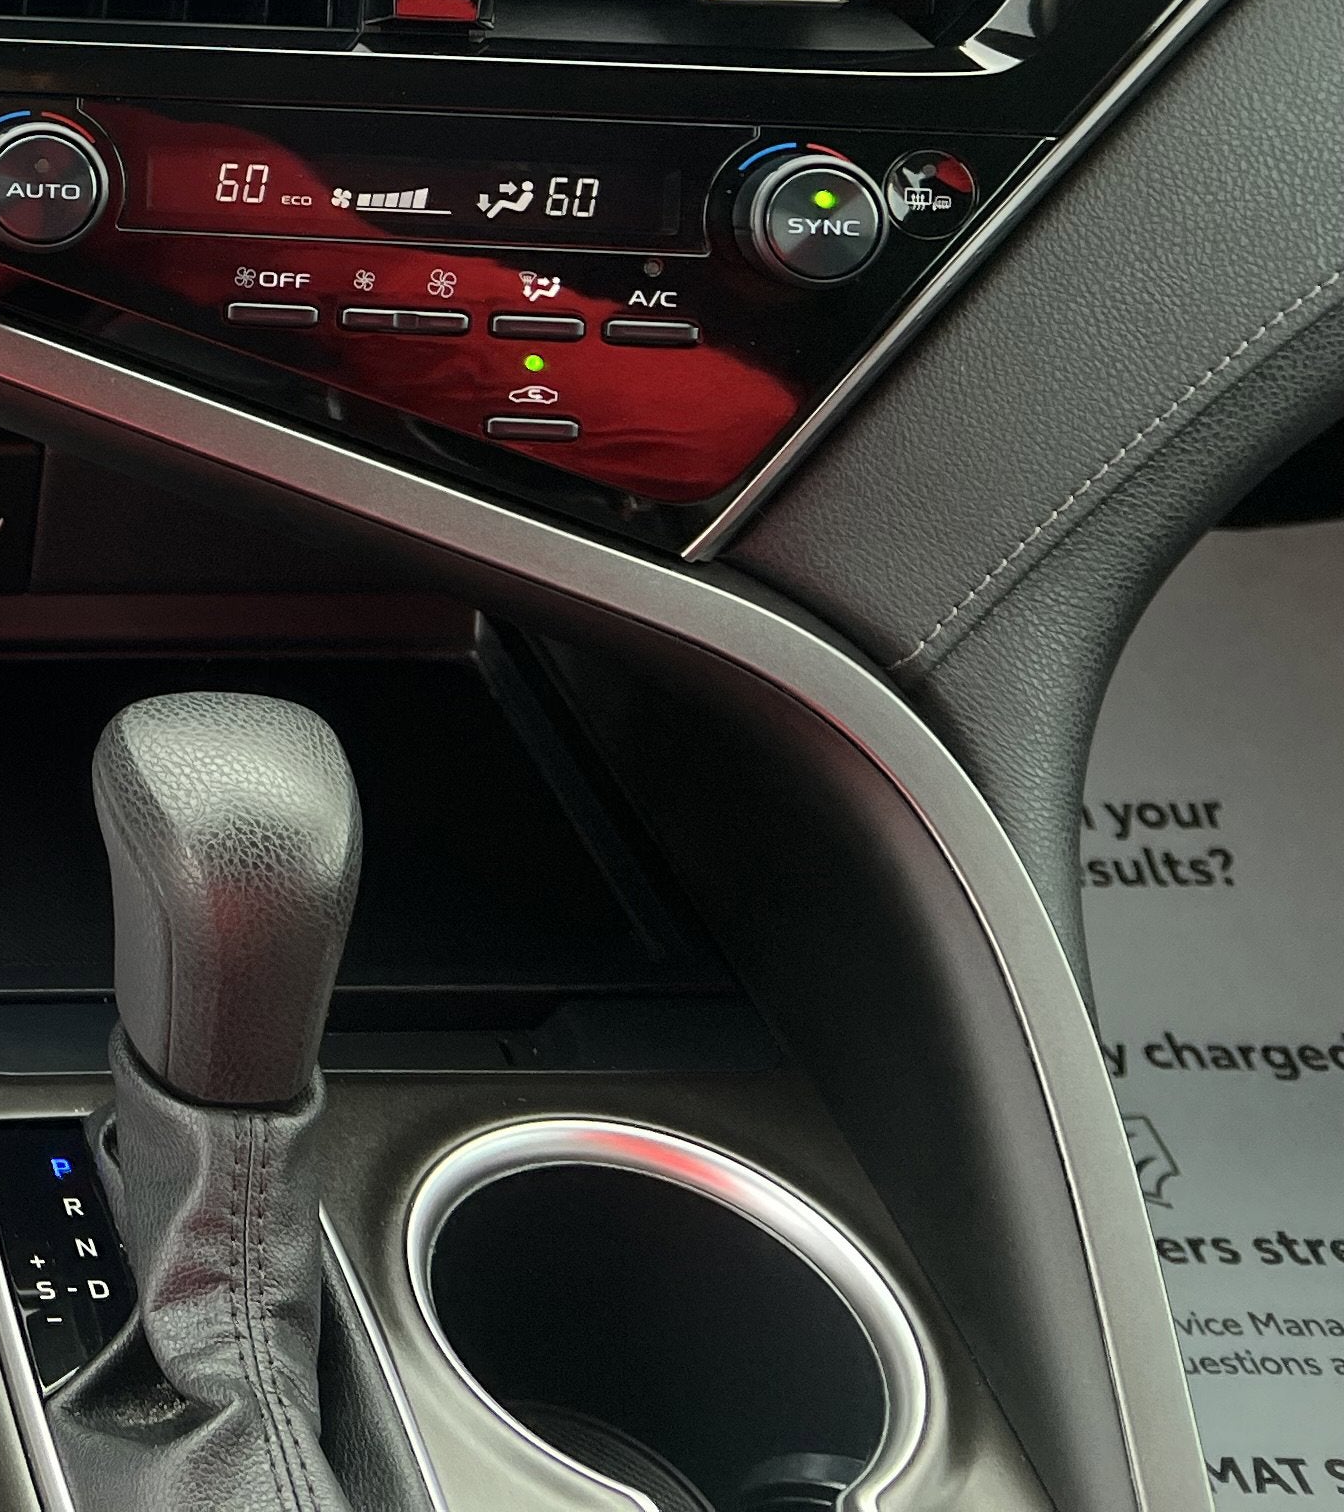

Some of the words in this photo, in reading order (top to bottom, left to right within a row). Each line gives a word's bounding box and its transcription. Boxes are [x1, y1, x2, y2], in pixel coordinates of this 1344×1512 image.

[5, 183, 81, 201] AUTO
[215, 163, 269, 205] 60
[281, 195, 313, 206] ECO
[545, 177, 600, 218] 60
[787, 217, 861, 238] SYNC
[258, 271, 311, 289] OFF
[628, 290, 678, 308] A/C
[1103, 800, 1223, 840] your
[1086, 847, 1235, 888] sults?
[50, 1157, 73, 1179] P
[63, 1197, 84, 1216] R
[74, 1238, 98, 1257] N
[1156, 1235, 1242, 1266] ers
[36, 1280, 56, 1300] S
[87, 1279, 110, 1299] D
[1174, 1310, 1244, 1337] vice
[1247, 1311, 1344, 1337] Mana
[1186, 1349, 1323, 1376] uestions
